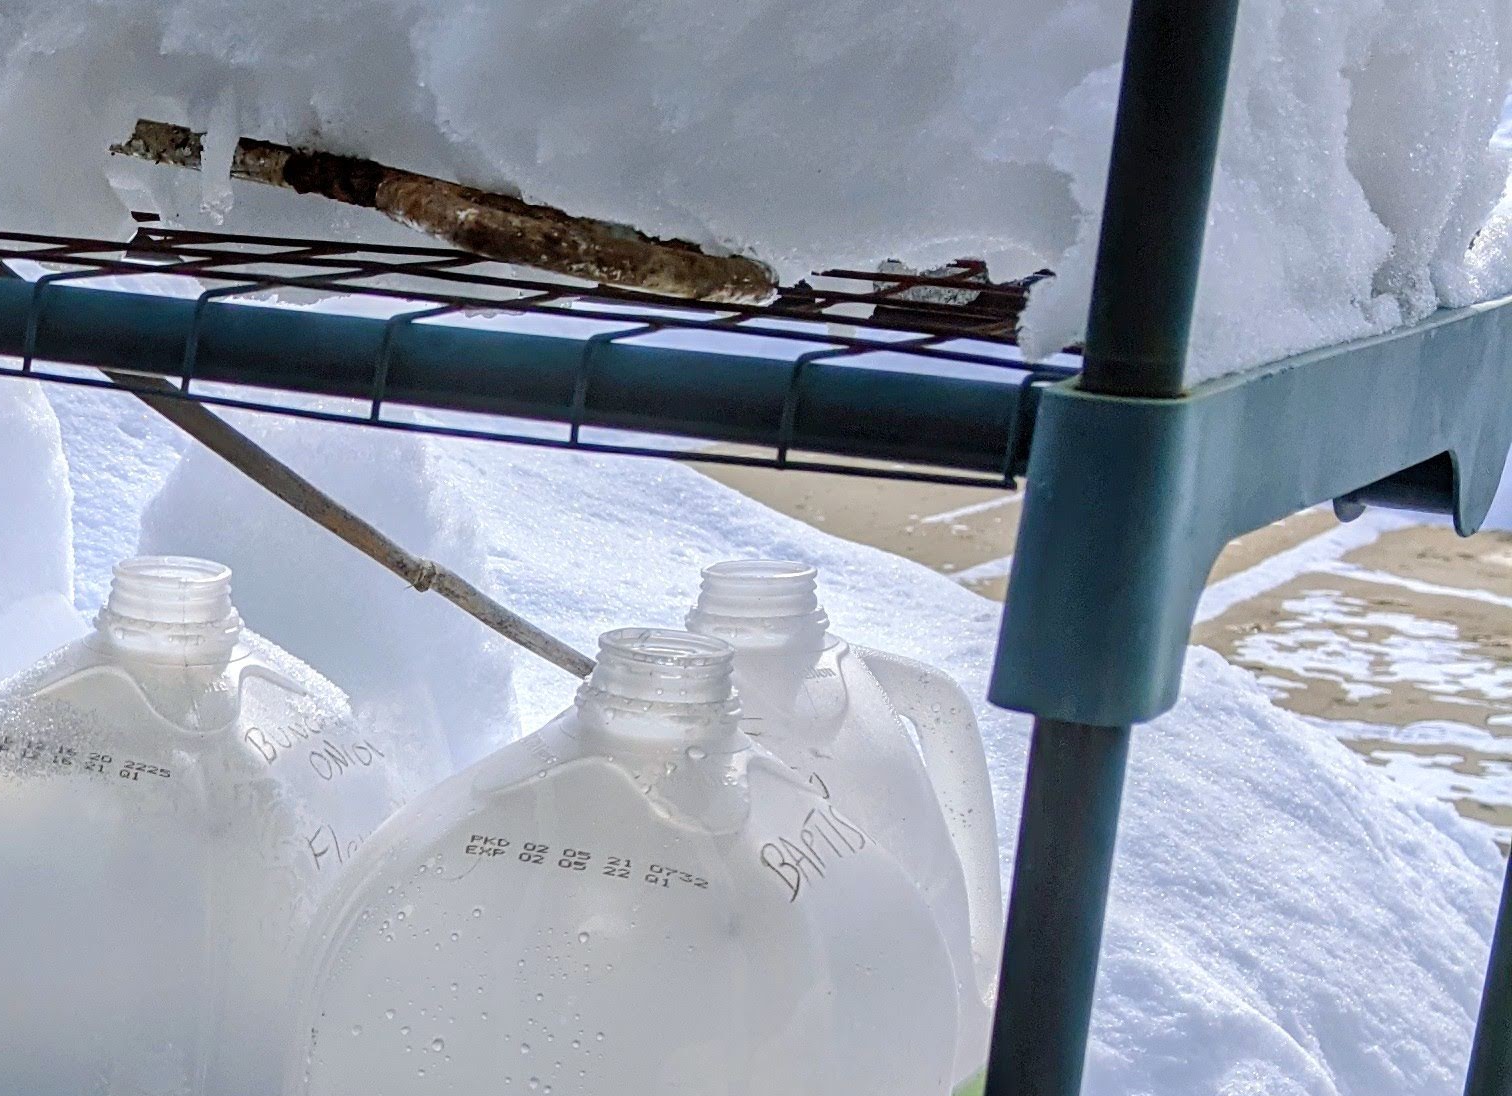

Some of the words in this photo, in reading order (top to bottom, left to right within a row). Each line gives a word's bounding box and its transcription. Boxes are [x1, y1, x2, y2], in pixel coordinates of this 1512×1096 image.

[89, 752, 112, 764] 20
[124, 760, 171, 778] 2225
[465, 845, 506, 857] EXP
[518, 852, 544, 865] 02
[558, 858, 587, 871] 05
[602, 866, 630, 879] 22
[470, 834, 510, 848] PKD
[523, 842, 549, 854] 02
[562, 848, 591, 861] 05
[607, 856, 631, 868] 21
[649, 863, 709, 889] 0732
